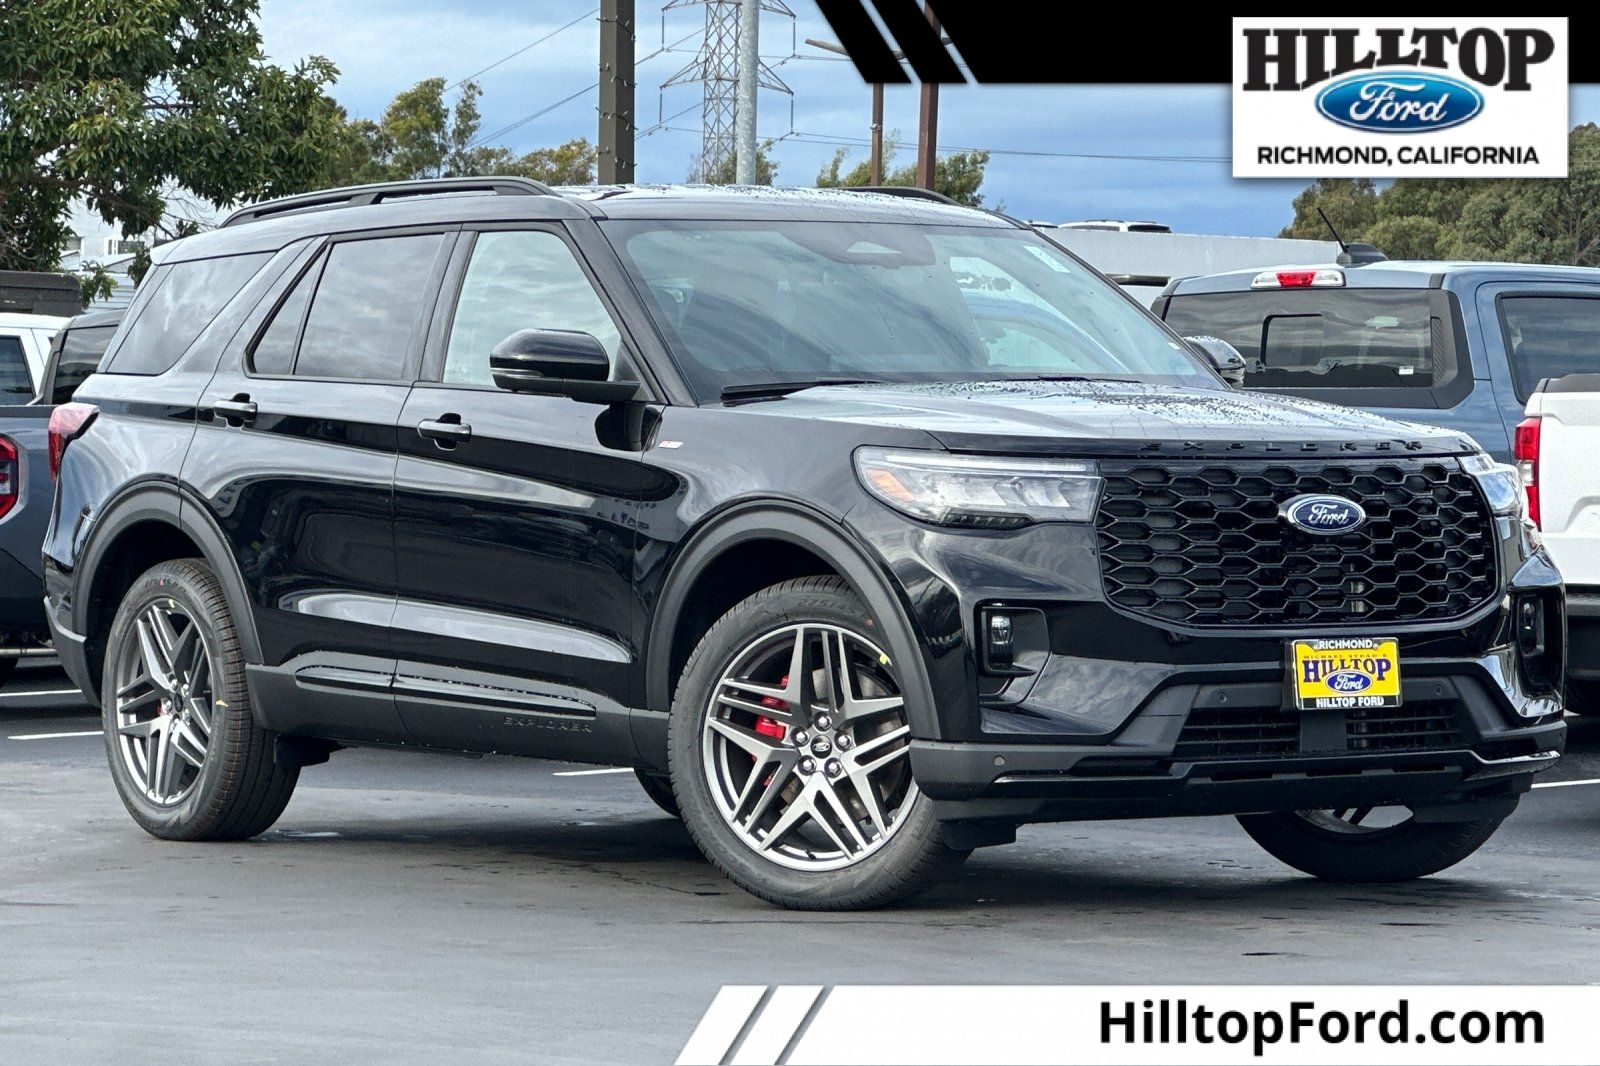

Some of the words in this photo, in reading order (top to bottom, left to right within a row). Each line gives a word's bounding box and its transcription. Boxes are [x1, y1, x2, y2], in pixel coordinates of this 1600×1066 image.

[1140, 441, 1423, 451] EXPLORER
[1307, 503, 1350, 525] Ford
[1318, 638, 1373, 650] RICHMOND
[1302, 658, 1392, 683] HILLTOP
[1334, 673, 1364, 690] Ford
[1316, 697, 1356, 708] HILLTOP
[1357, 695, 1385, 707] FORD
